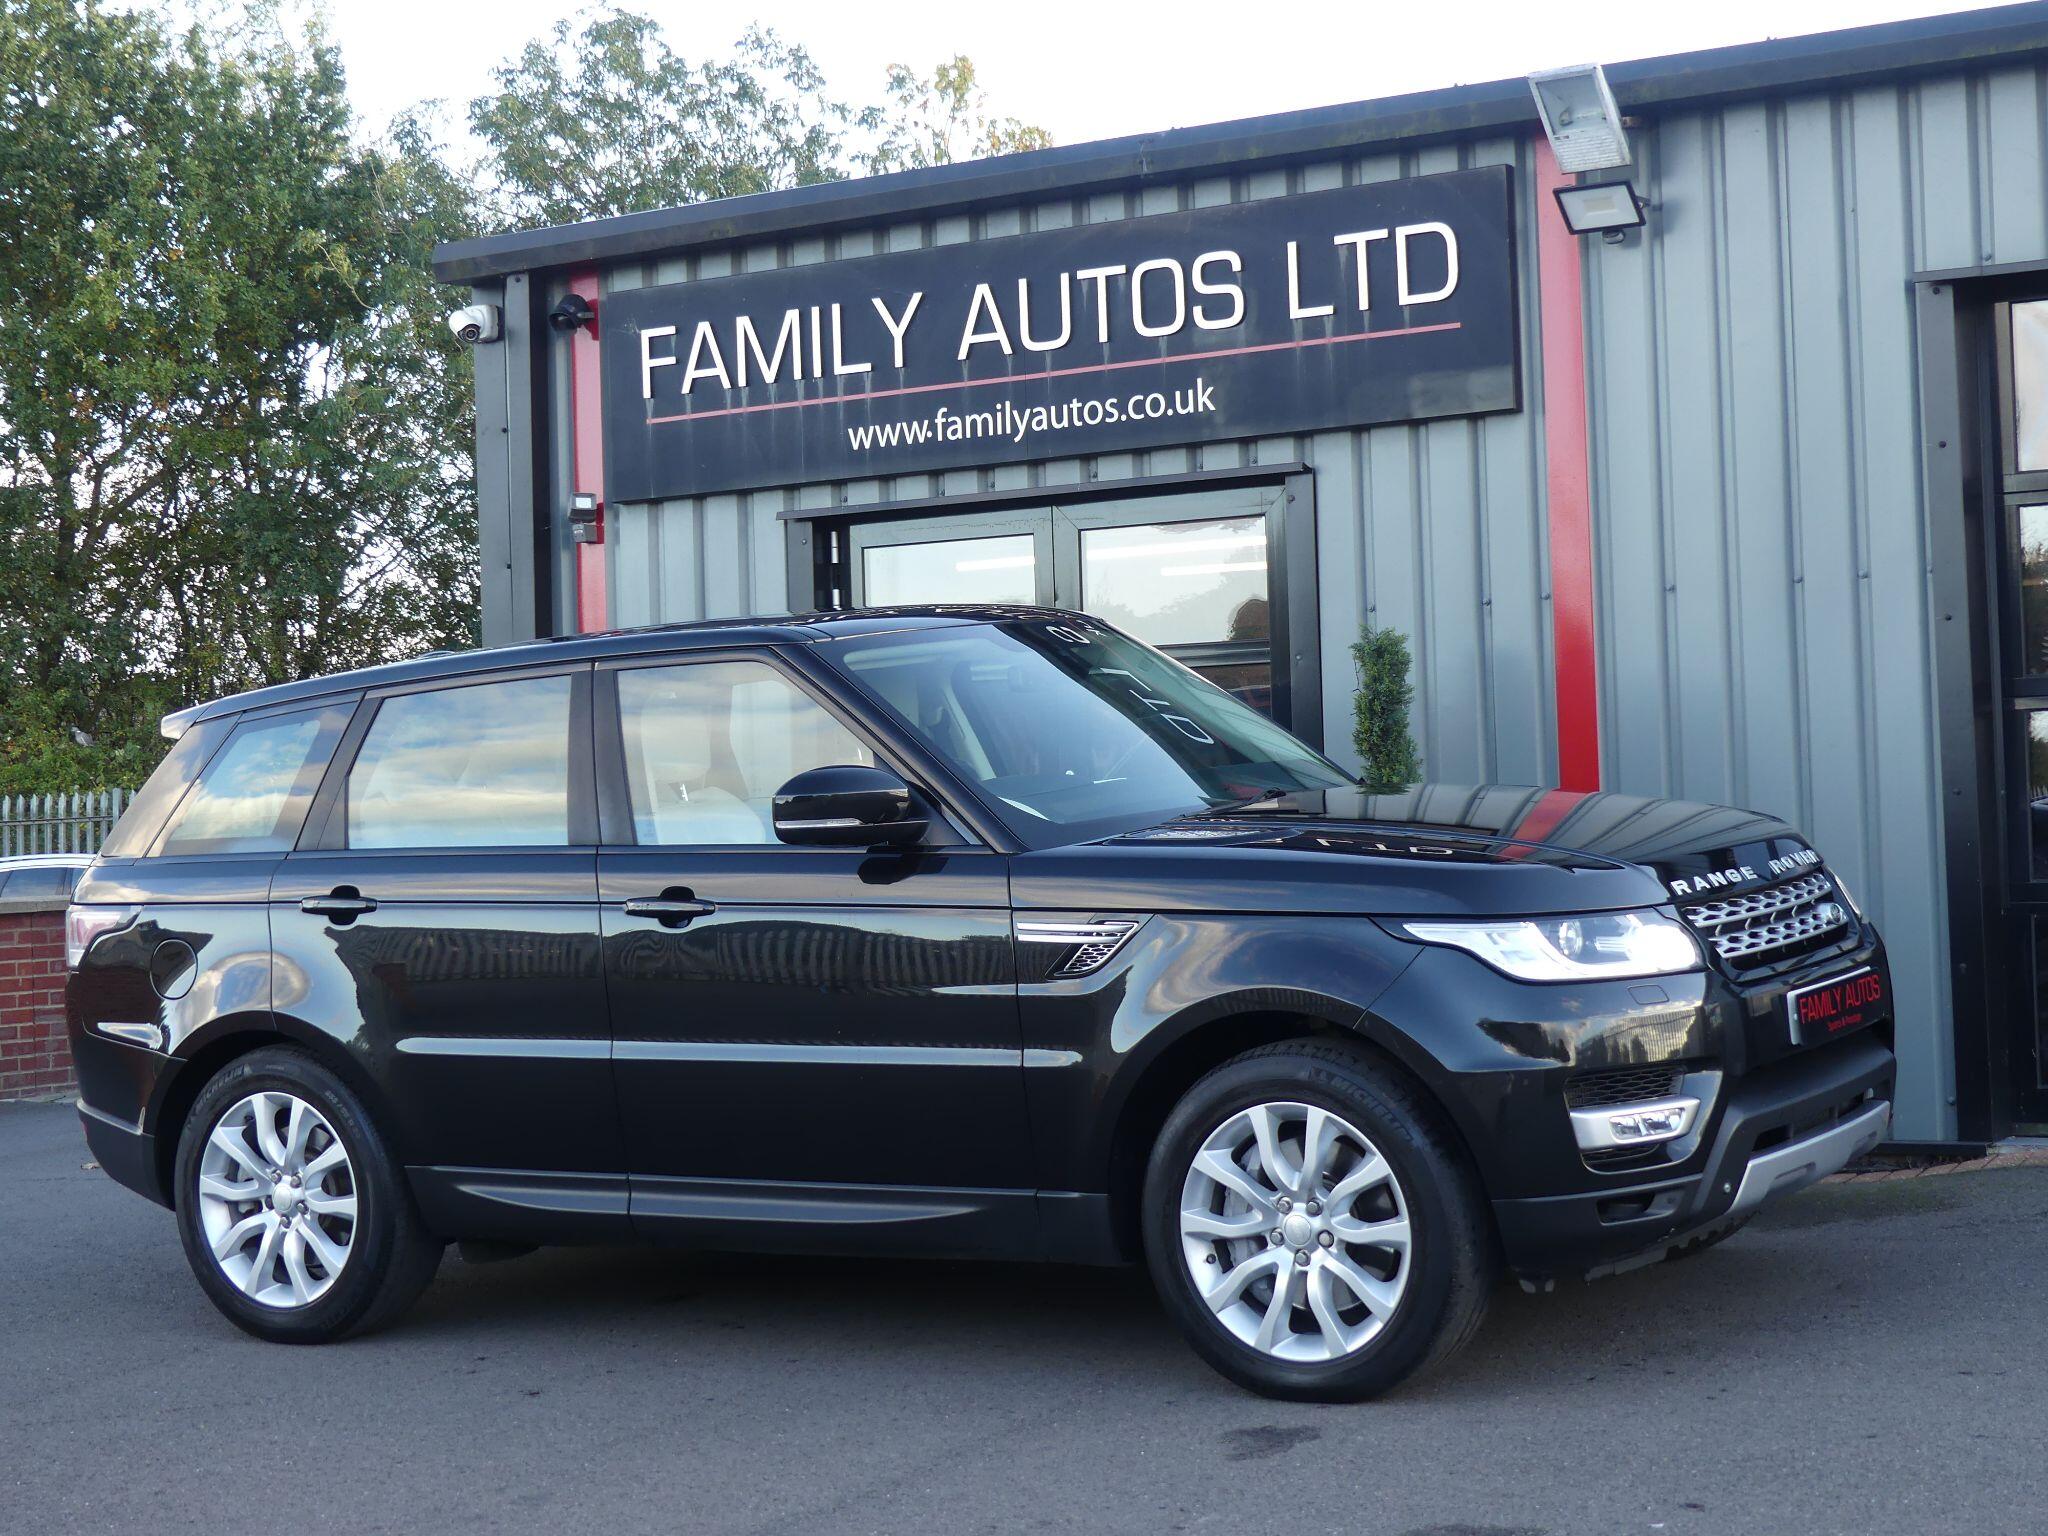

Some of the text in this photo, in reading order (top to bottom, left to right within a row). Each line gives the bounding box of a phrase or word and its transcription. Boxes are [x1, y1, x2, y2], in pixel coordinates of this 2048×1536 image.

[640, 221, 1460, 399] FAMILY AUTOS LTD
[847, 377, 1217, 451] www.familyautos.co.uk
[1670, 865, 1759, 896] RANGE
[1800, 988, 1842, 1025] FAMILY
[1845, 974, 1881, 1009] AUTOS
[1330, 1075, 1414, 1142] MICHELIN
